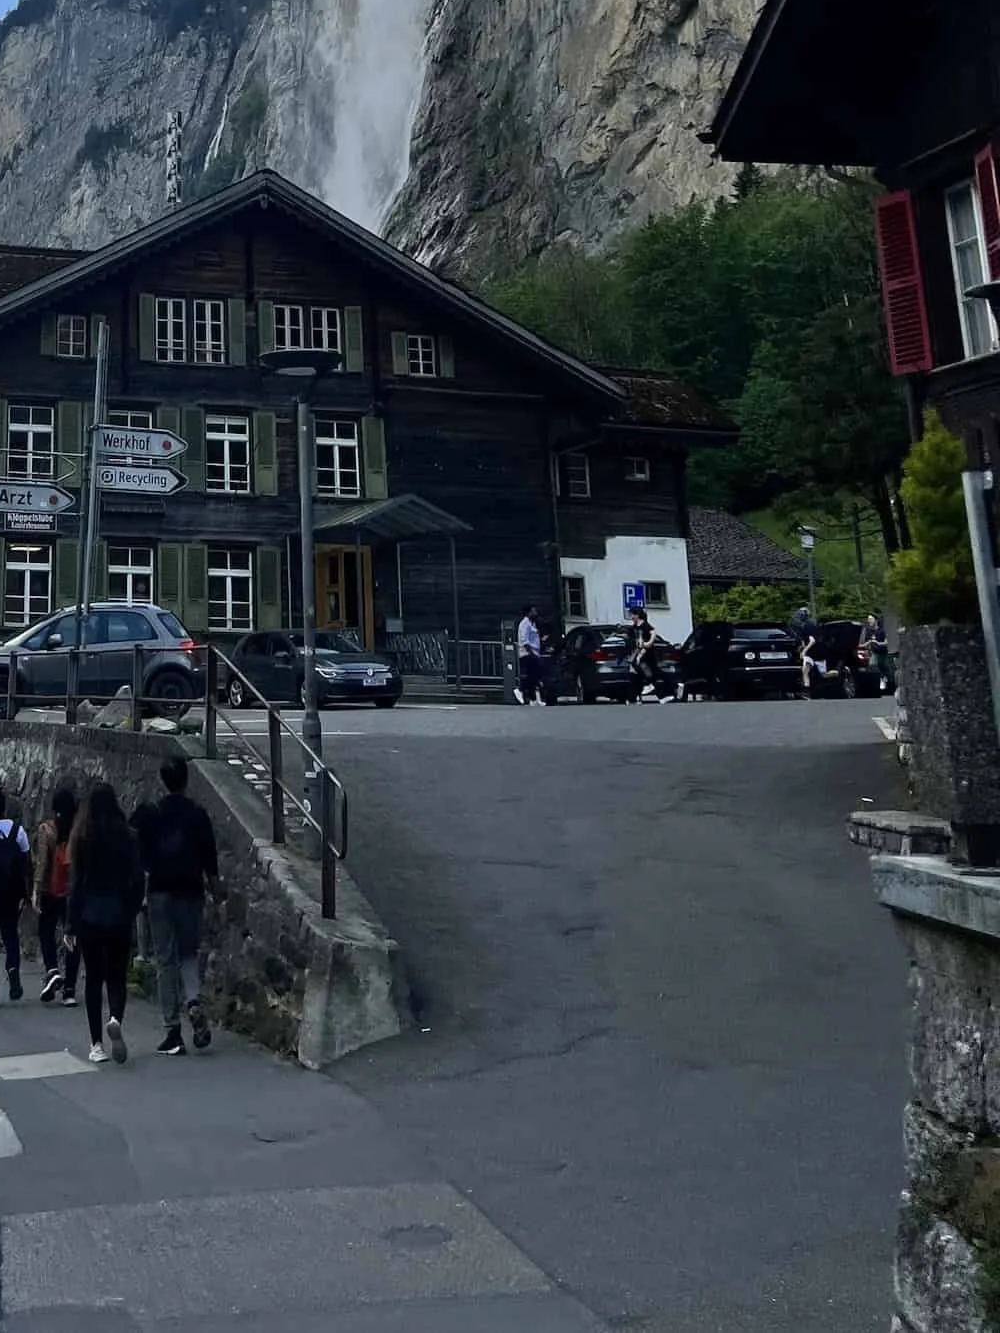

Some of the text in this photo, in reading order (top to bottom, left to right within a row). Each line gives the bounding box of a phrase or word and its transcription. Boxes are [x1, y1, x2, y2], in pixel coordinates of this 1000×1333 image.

[102, 433, 151, 451] Werkhof
[118, 471, 167, 488] Recycling
[625, 585, 636, 604] P
